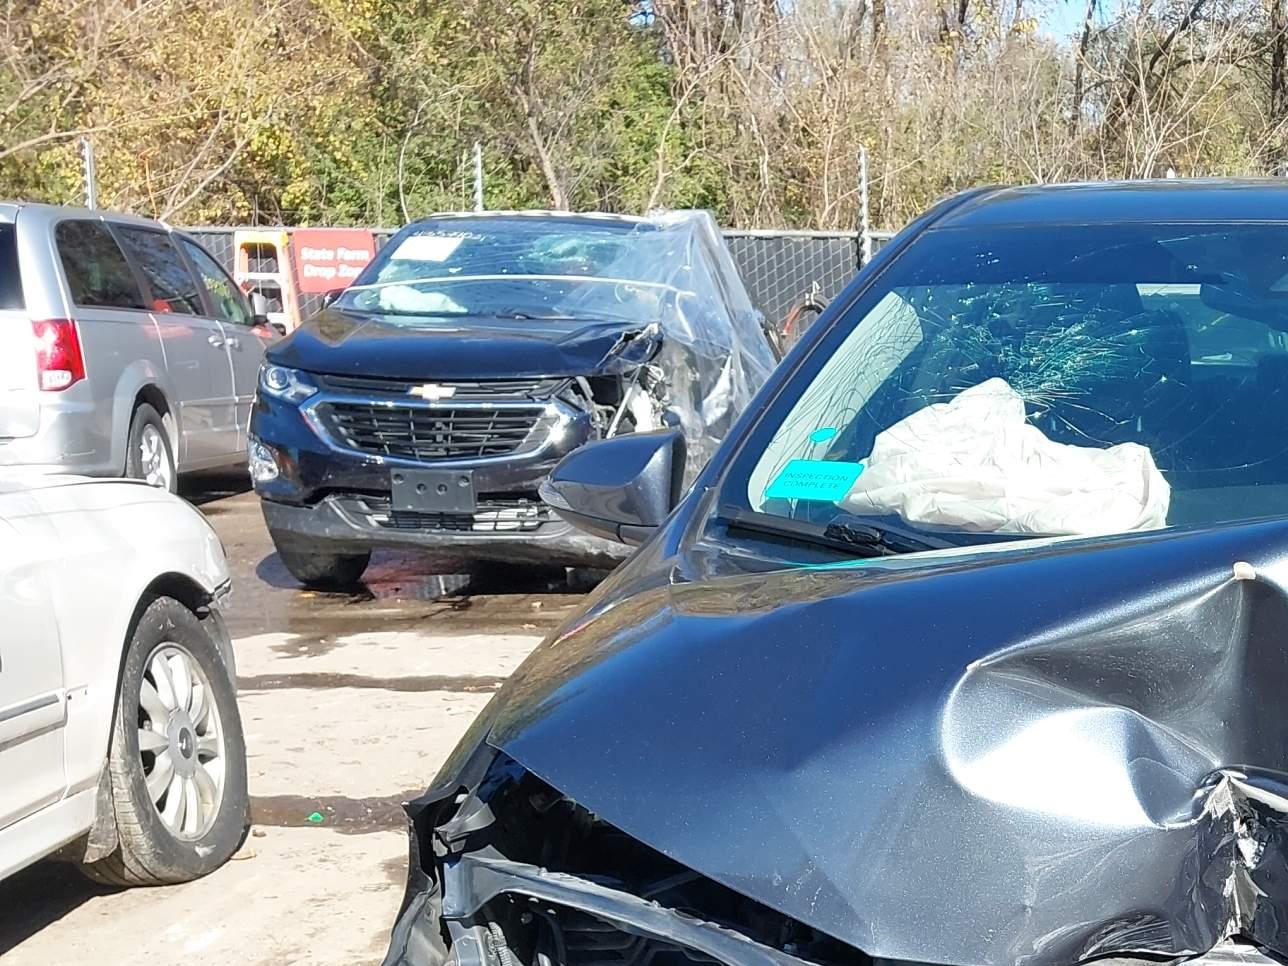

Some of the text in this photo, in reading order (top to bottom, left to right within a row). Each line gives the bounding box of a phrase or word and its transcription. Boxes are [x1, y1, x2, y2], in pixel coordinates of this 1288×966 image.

[338, 264, 363, 278] Zon
[784, 472, 849, 482] INSPECTION
[783, 481, 841, 490] COMPLETE
